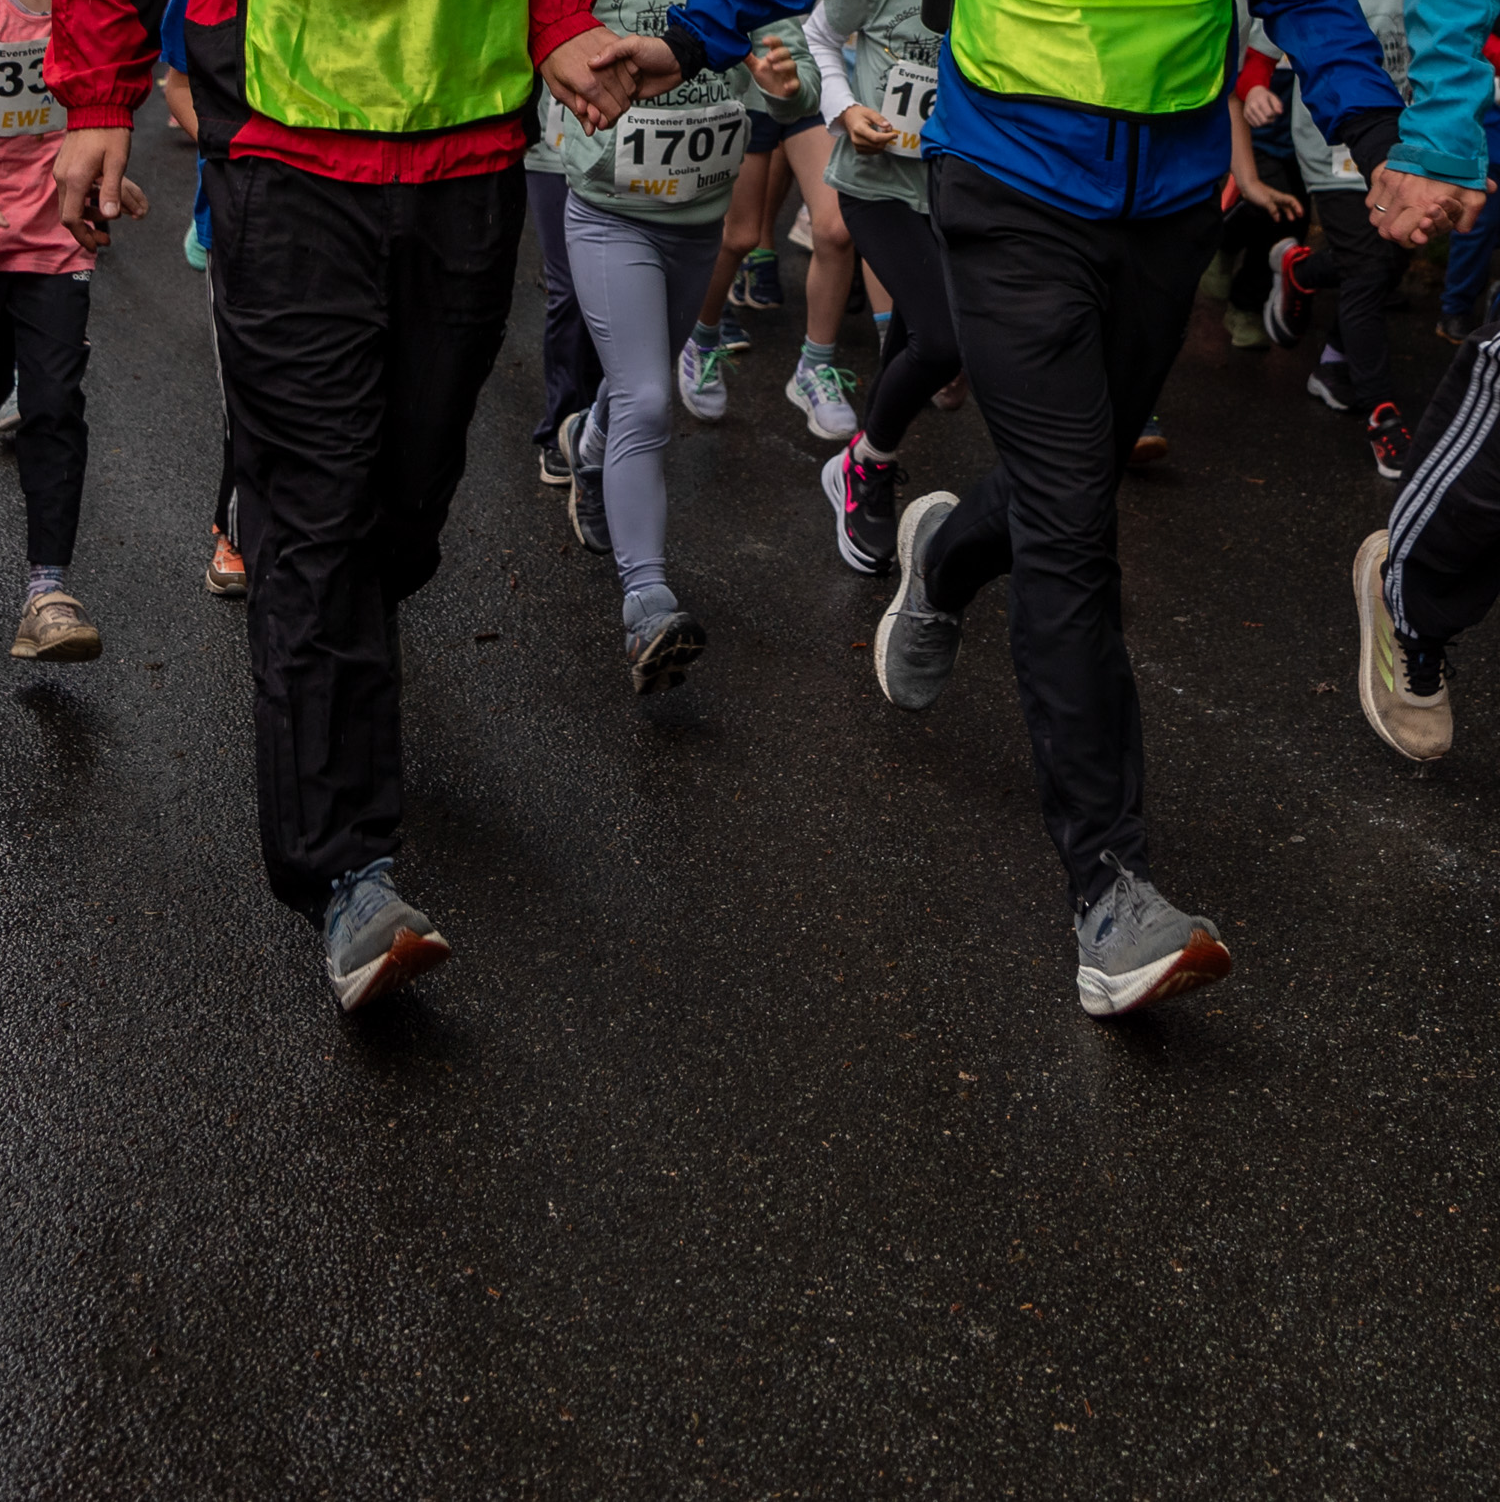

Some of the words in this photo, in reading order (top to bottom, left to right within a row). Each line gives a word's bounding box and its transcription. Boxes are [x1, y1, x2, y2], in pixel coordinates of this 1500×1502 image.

[1, 107, 52, 129] EWE
[627, 115, 683, 126] Everstener
[686, 109, 741, 126] Brunnenlauf
[623, 119, 743, 166] 1707
[668, 166, 701, 176] Louisa
[696, 169, 732, 189] bruns
[628, 179, 680, 196] EWE
